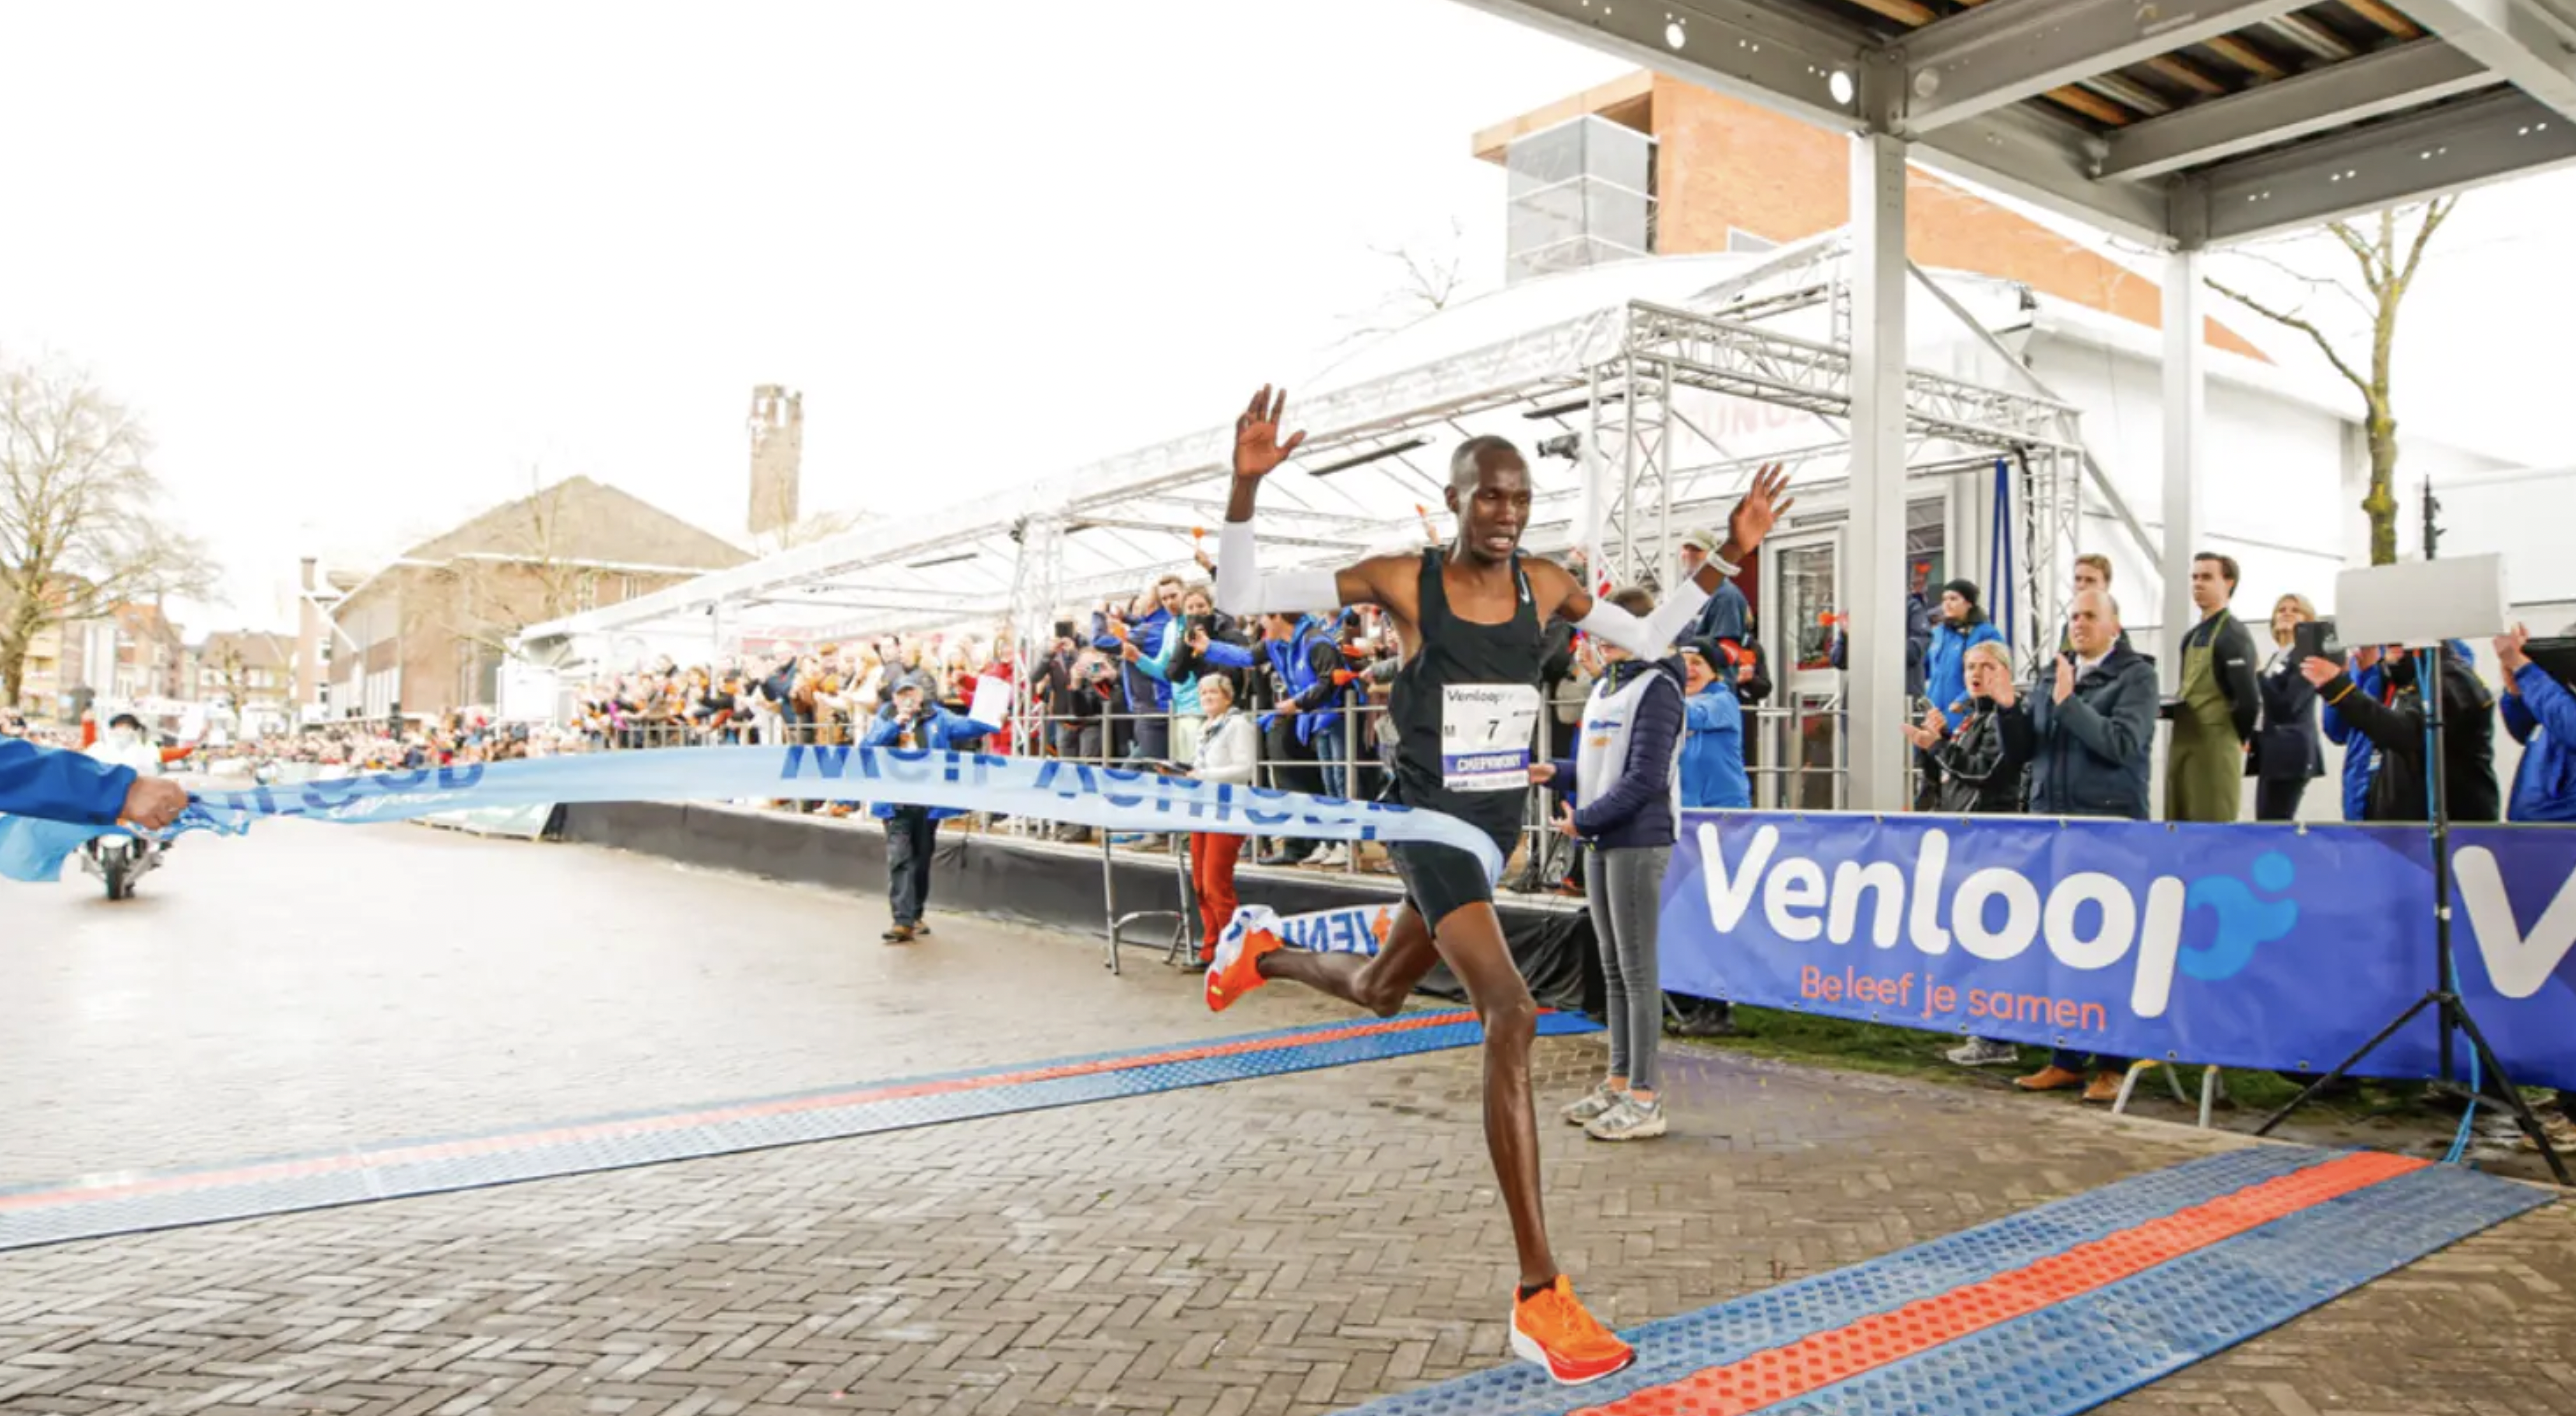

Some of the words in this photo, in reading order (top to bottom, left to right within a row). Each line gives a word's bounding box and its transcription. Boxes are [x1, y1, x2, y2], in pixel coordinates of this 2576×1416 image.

[1488, 719, 1500, 740] 7
[1697, 822, 2255, 1018] Venloop
[1801, 965, 1914, 1005] Beleef
[1921, 974, 1956, 1019] je
[1968, 984, 2106, 1031] samen
